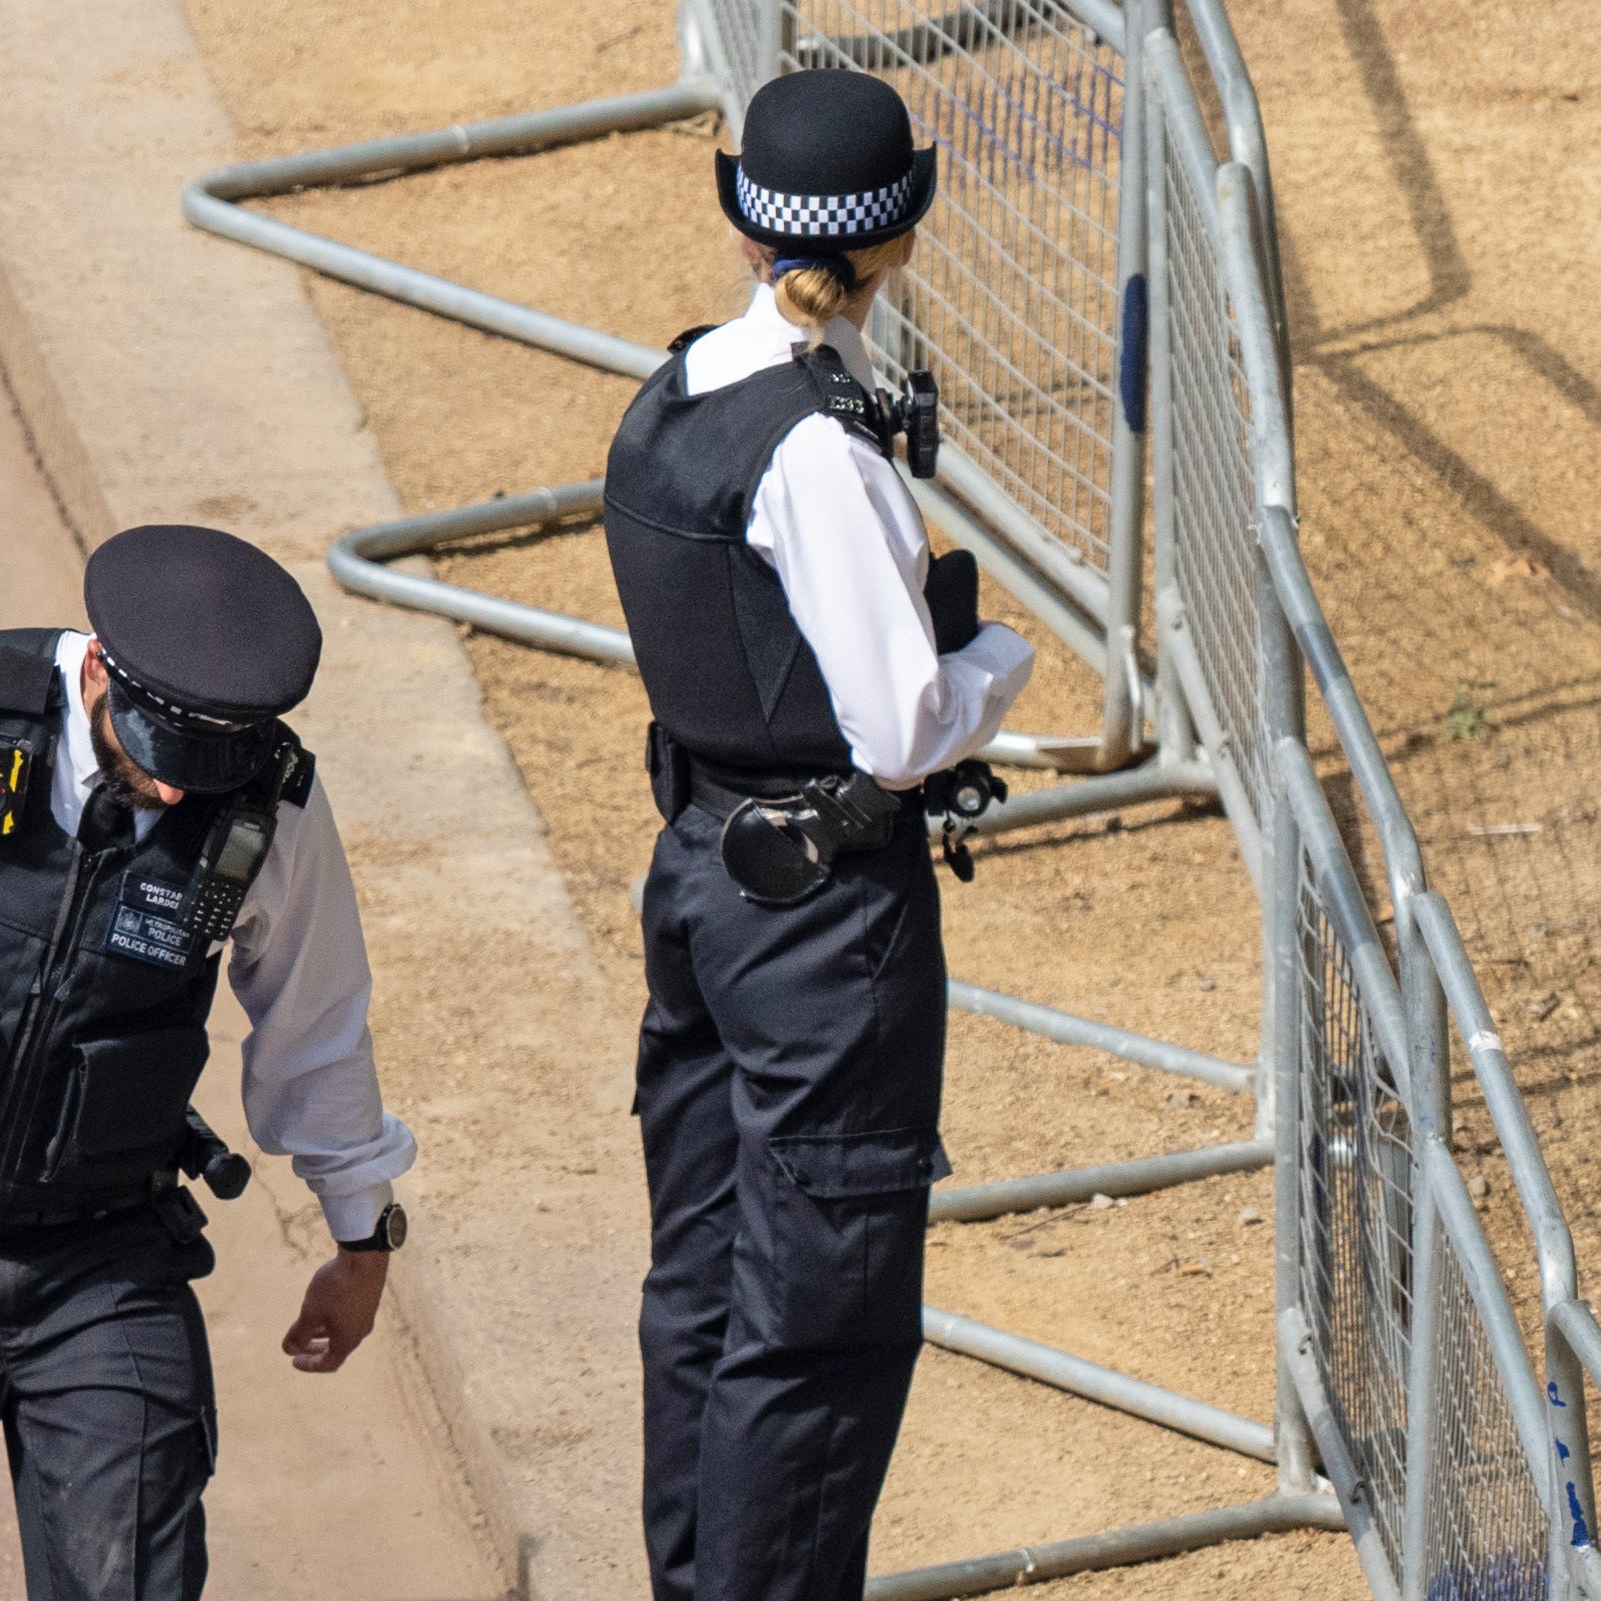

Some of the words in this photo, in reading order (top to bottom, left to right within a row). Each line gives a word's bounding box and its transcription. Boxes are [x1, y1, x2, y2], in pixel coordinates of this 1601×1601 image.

[111, 933, 149, 954] POLICE
[147, 945, 187, 967] OFFICER
[147, 927, 183, 947] POLICE
